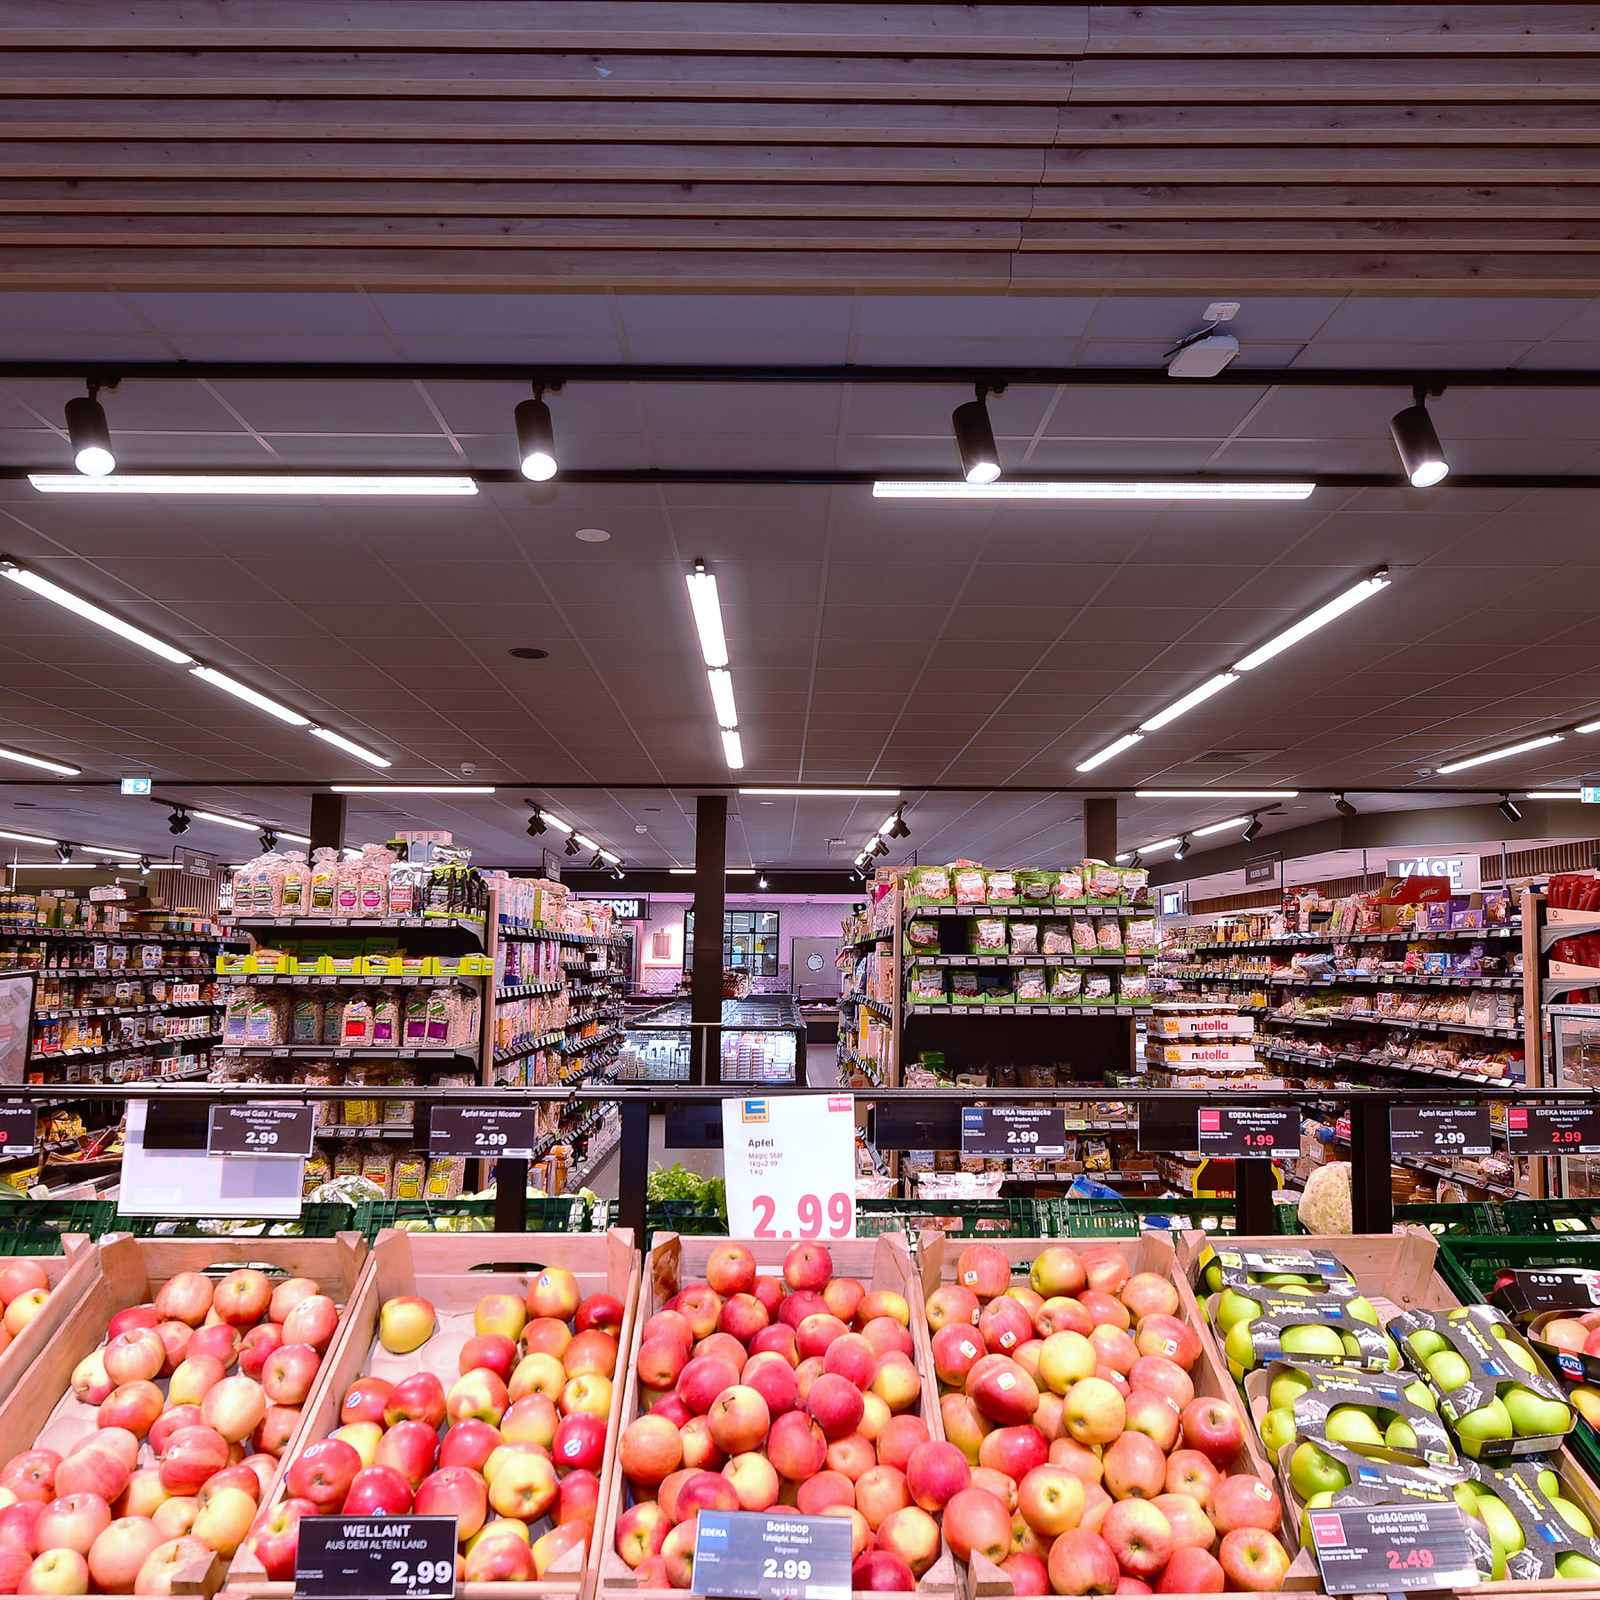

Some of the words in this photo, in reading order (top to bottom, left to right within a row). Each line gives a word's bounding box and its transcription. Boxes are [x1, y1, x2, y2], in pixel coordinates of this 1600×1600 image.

[1190, 1020, 1228, 1031] nutella
[1191, 1049, 1229, 1060] nutella
[230, 1109, 250, 1118] Royal
[461, 1109, 478, 1118] Äpfel
[1016, 1108, 1052, 1116] Herzstücke
[1418, 1109, 1435, 1117] Äpfel
[245, 1132, 278, 1145] 2.99
[475, 1133, 507, 1146] 2.99
[1006, 1131, 1039, 1143] 2.99
[1244, 1134, 1275, 1146] 1.99
[1434, 1132, 1465, 1144] 2.99
[1552, 1131, 1582, 1142] 2.99
[748, 1138, 774, 1148] Äpfel
[748, 1153, 768, 1161] Magic
[752, 1192, 852, 1238] 2.99
[1559, 1356, 1582, 1371] KANZI
[1386, 1474, 1441, 1493] bergäpfel
[1367, 1512, 1427, 1524] Gut&Günstig
[343, 1525, 411, 1537] WELLANT
[701, 1528, 726, 1538] EDEKA
[767, 1521, 809, 1535] Boskoop
[1386, 1525, 1399, 1533] Gala
[325, 1540, 345, 1550] AUS
[346, 1540, 369, 1550] DEM
[369, 1540, 400, 1549] ALTEN
[401, 1540, 427, 1549] LAND
[1386, 1548, 1434, 1570] 2.49
[390, 1560, 452, 1588] 2,99
[763, 1558, 811, 1580] 2.99
